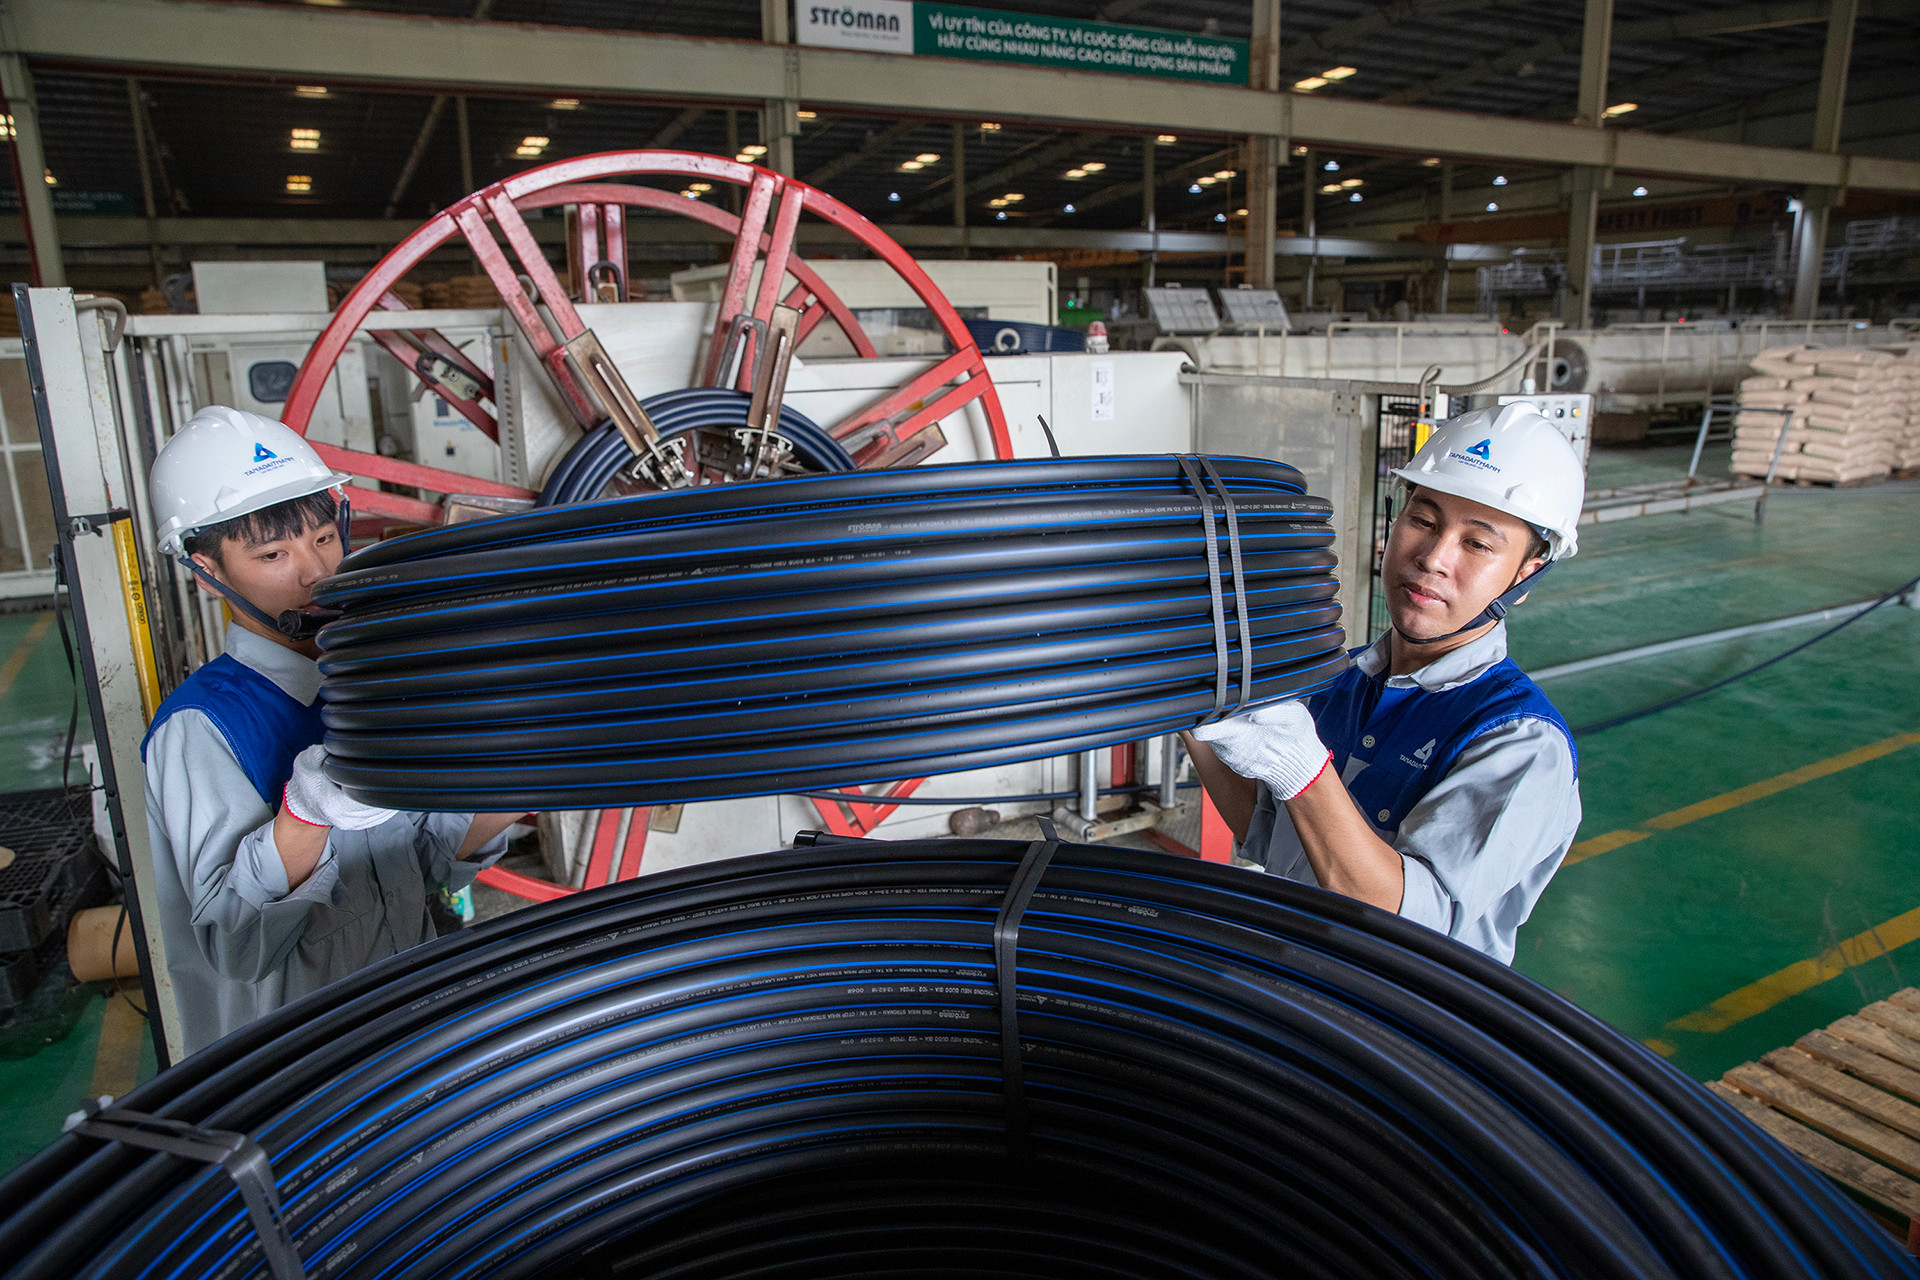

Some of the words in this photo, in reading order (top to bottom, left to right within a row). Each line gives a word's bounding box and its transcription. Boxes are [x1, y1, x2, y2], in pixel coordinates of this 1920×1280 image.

[929, 12, 943, 30] VÌ
[945, 16, 963, 32] UY
[963, 15, 986, 34] TÍN
[987, 19, 1014, 37] CỦA
[1014, 22, 1050, 41] CÔNG
[1069, 27, 1083, 45] VÌ
[1083, 31, 1115, 49] CUỘC
[1117, 33, 1149, 53] SỐNG
[938, 33, 963, 48] HÃY
[965, 35, 1000, 52] CÙNG
[1003, 40, 1039, 57] NHAU
[1041, 42, 1076, 60] NÂNG
[1077, 47, 1102, 63] CAO
[1103, 48, 1133, 66] CHẤT
[1134, 53, 1176, 71] LƯỢNG
[1176, 57, 1197, 73] SẢN
[1198, 58, 1231, 77] PHẨM
